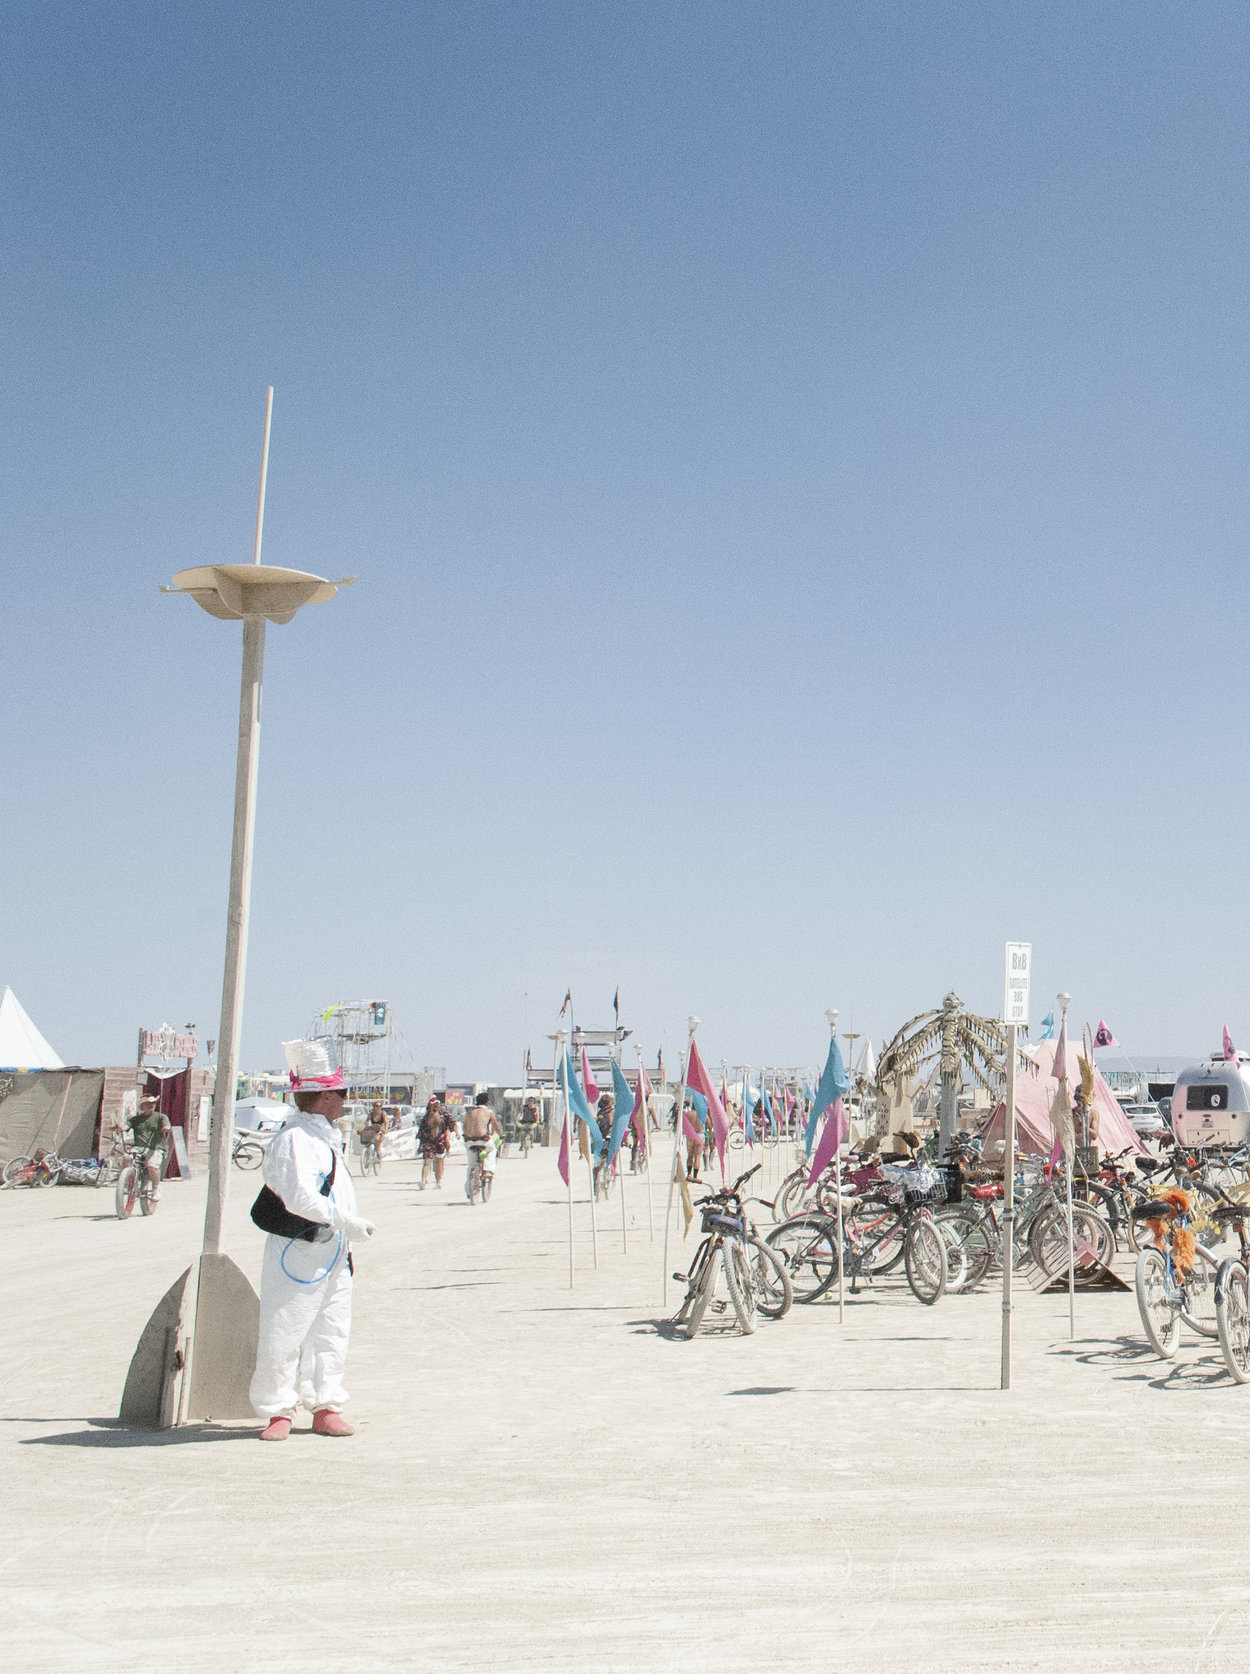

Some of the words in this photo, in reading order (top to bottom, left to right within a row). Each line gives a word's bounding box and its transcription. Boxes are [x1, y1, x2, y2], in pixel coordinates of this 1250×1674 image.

[1012, 953, 1027, 970] BxB
[1009, 978, 1028, 989] SATELLITE
[1013, 991, 1023, 1002] BUS
[1012, 1006, 1023, 1017] STOP
